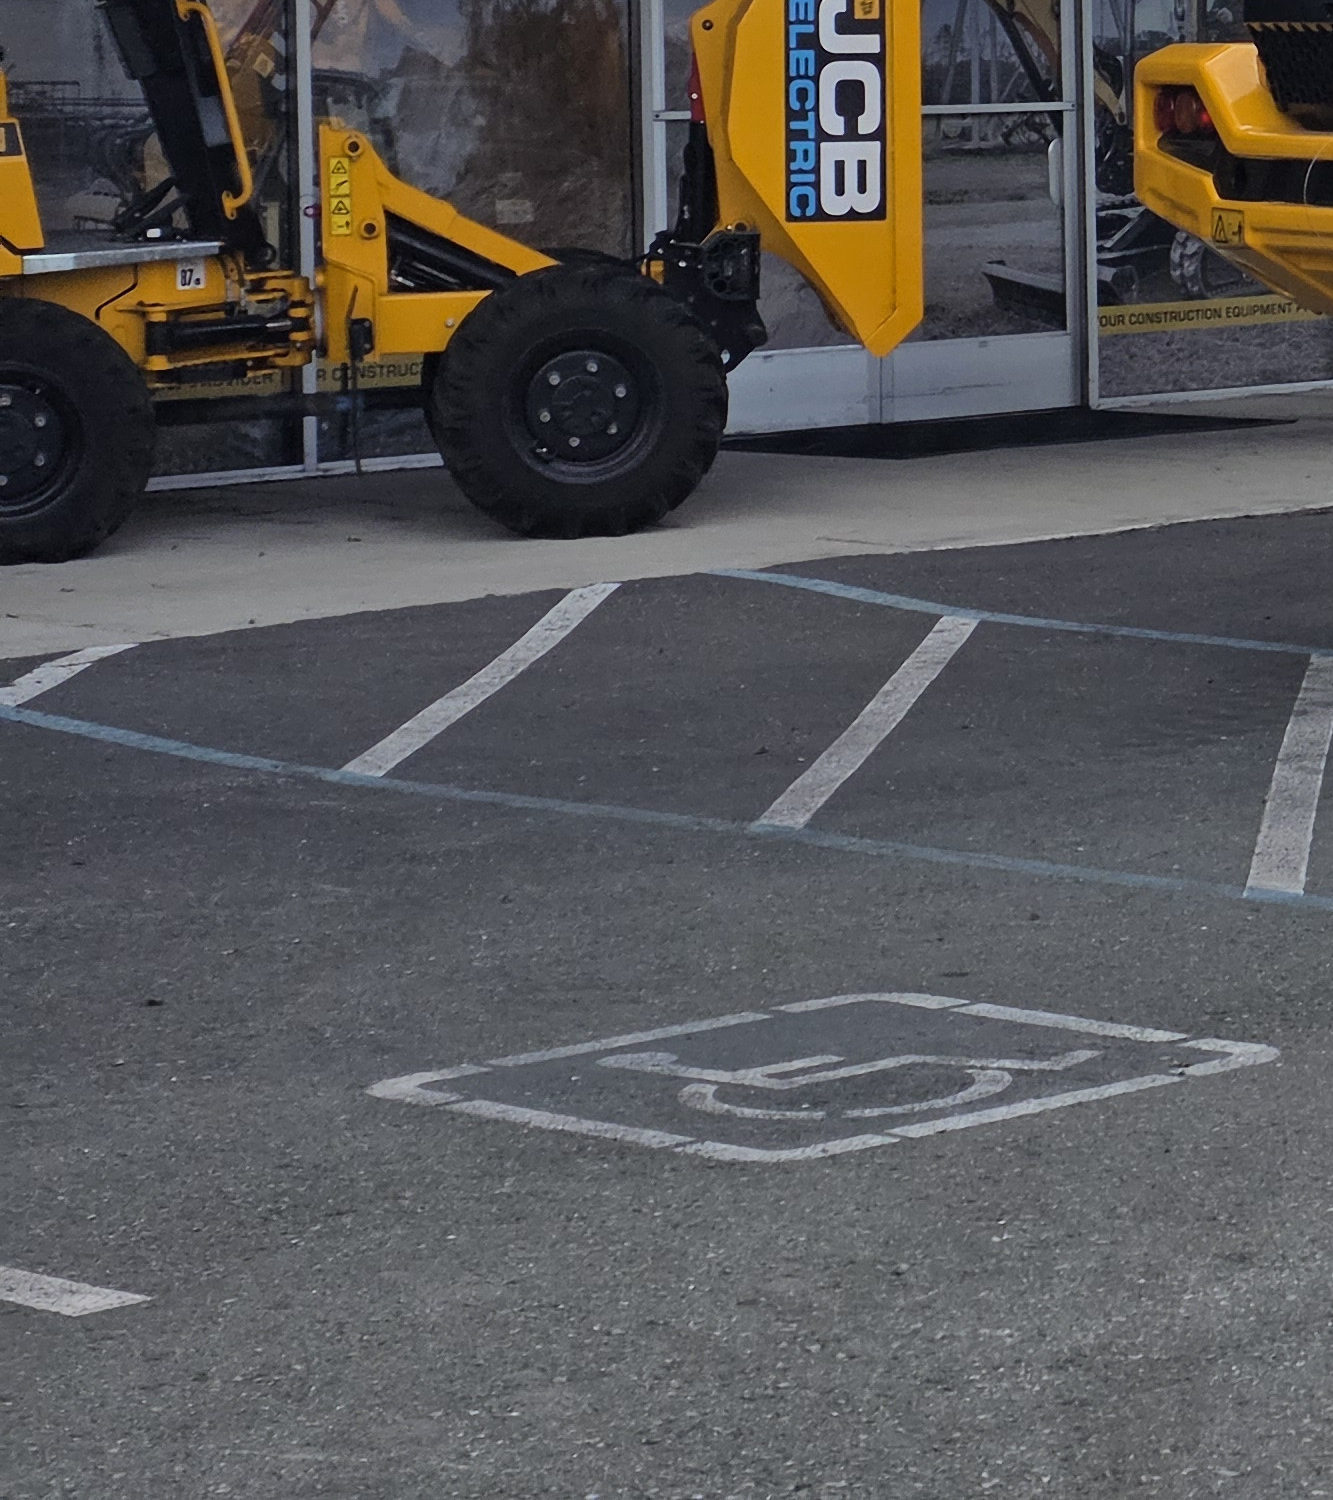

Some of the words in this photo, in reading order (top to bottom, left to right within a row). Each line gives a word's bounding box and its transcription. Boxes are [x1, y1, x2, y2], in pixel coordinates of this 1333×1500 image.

[1097, 313, 1126, 328] OUR
[1128, 307, 1219, 327] CONSTRUCTION
[1225, 302, 1293, 319] EQUIPMENT
